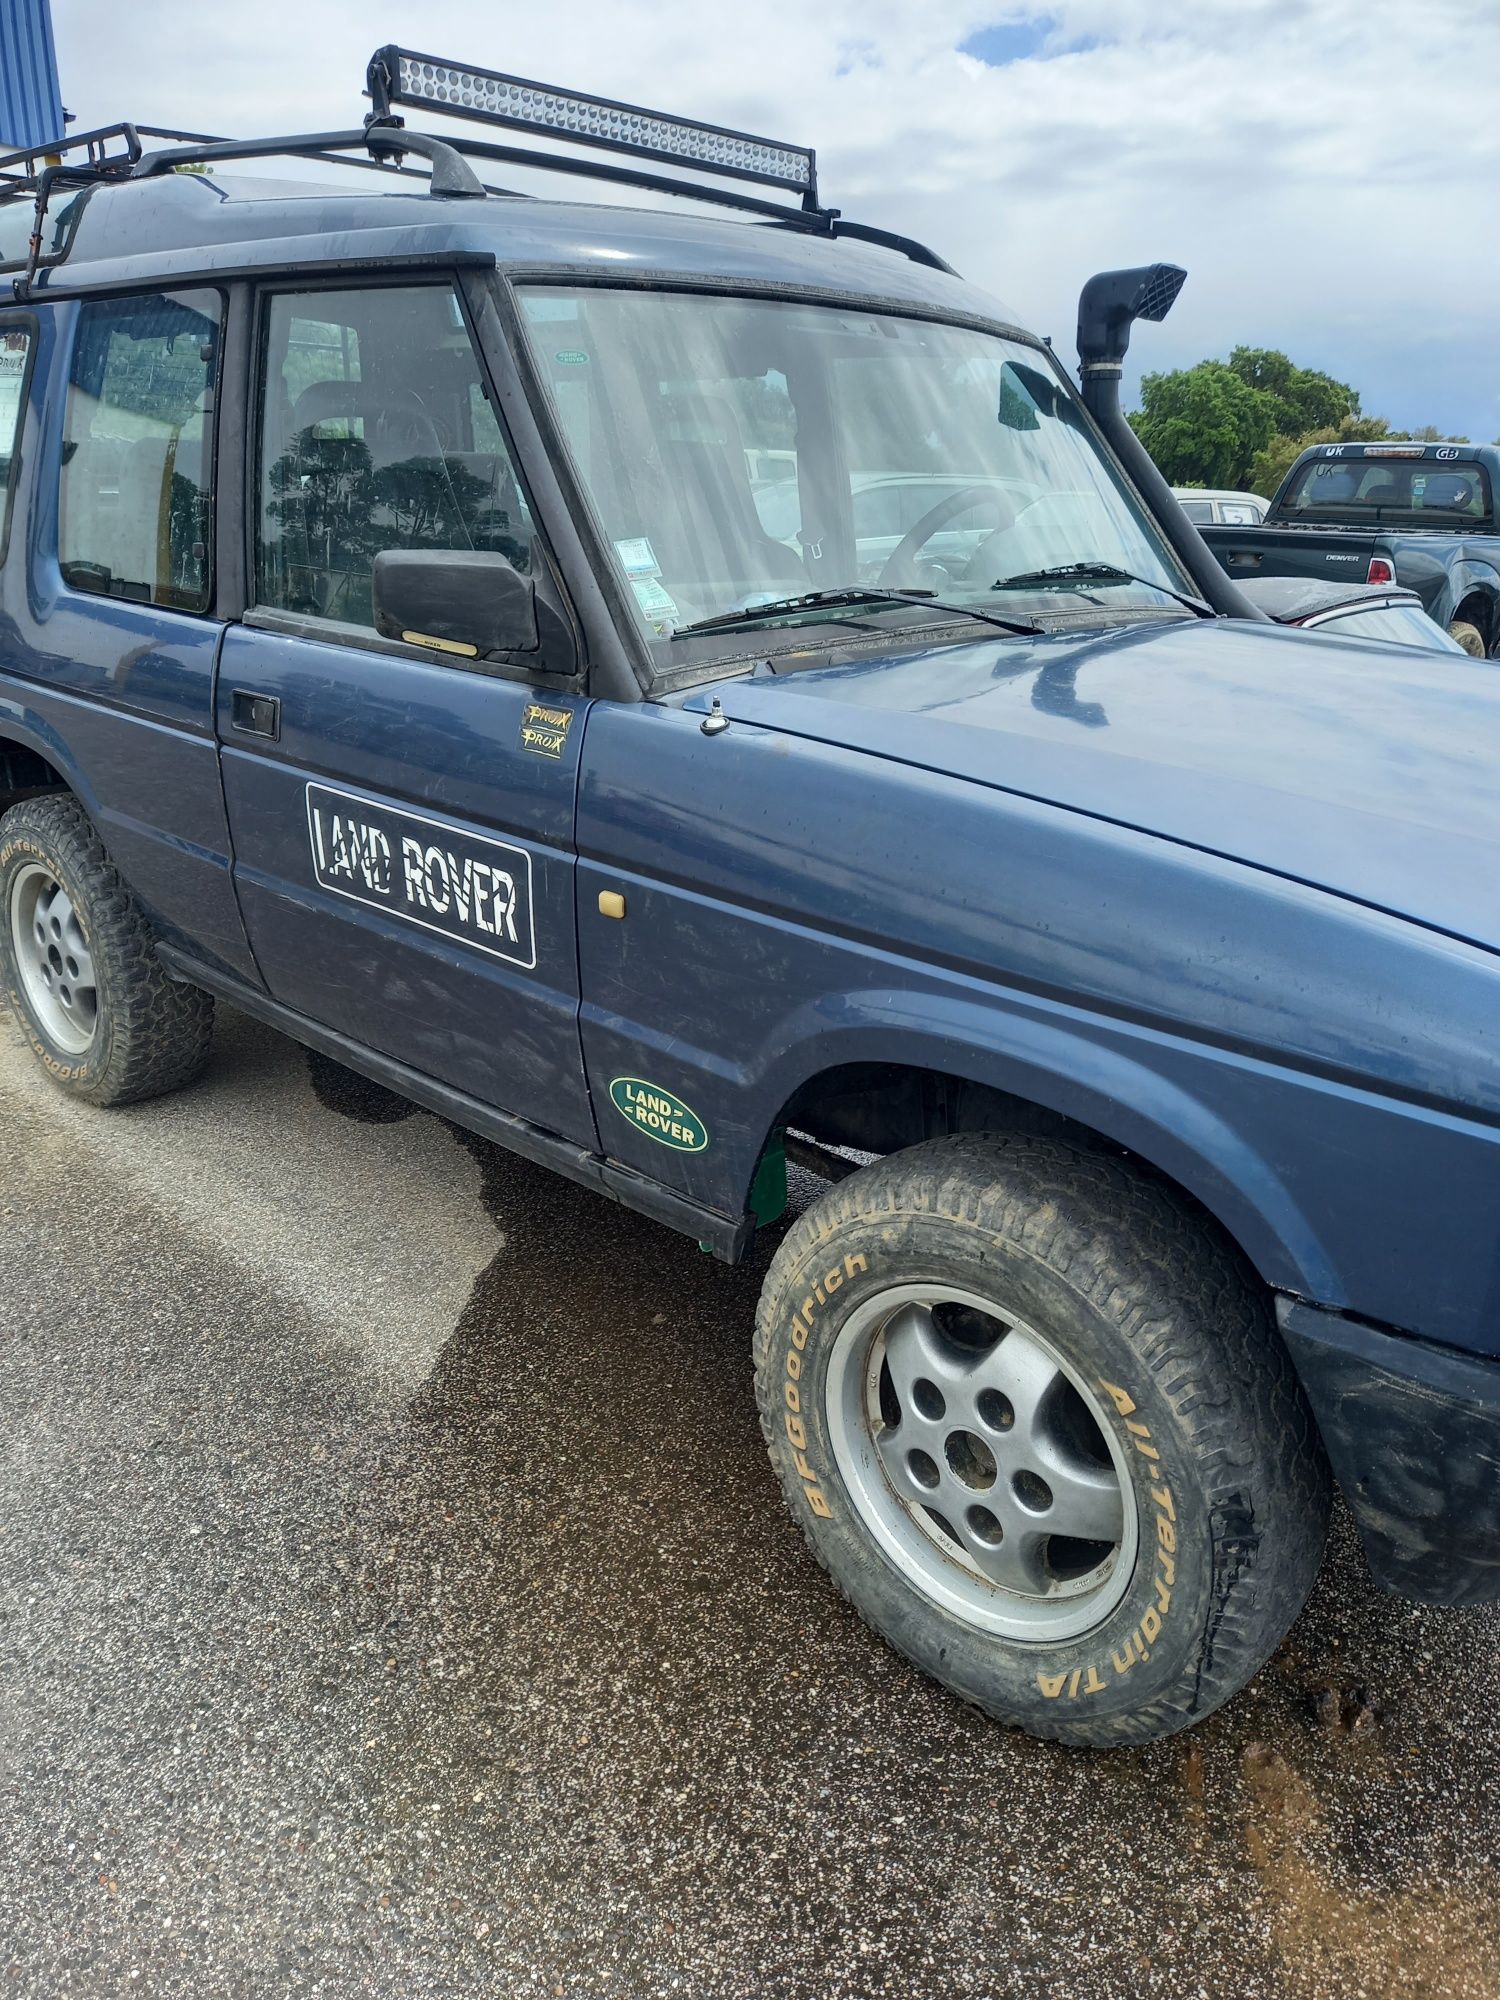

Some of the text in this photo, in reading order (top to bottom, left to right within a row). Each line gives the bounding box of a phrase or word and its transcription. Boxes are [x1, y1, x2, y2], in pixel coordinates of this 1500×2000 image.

[1325, 446, 1345, 457] UK
[1438, 448, 1458, 459] GB
[1325, 554, 1359, 562] DENVER
[313, 808, 519, 943] LAND ROVER
[626, 1084, 672, 1117] LAND
[636, 1105, 695, 1146] ROVER
[784, 1252, 868, 1520] BFGoodrich
[1036, 1376, 1177, 1699] All-Terrain T/A
